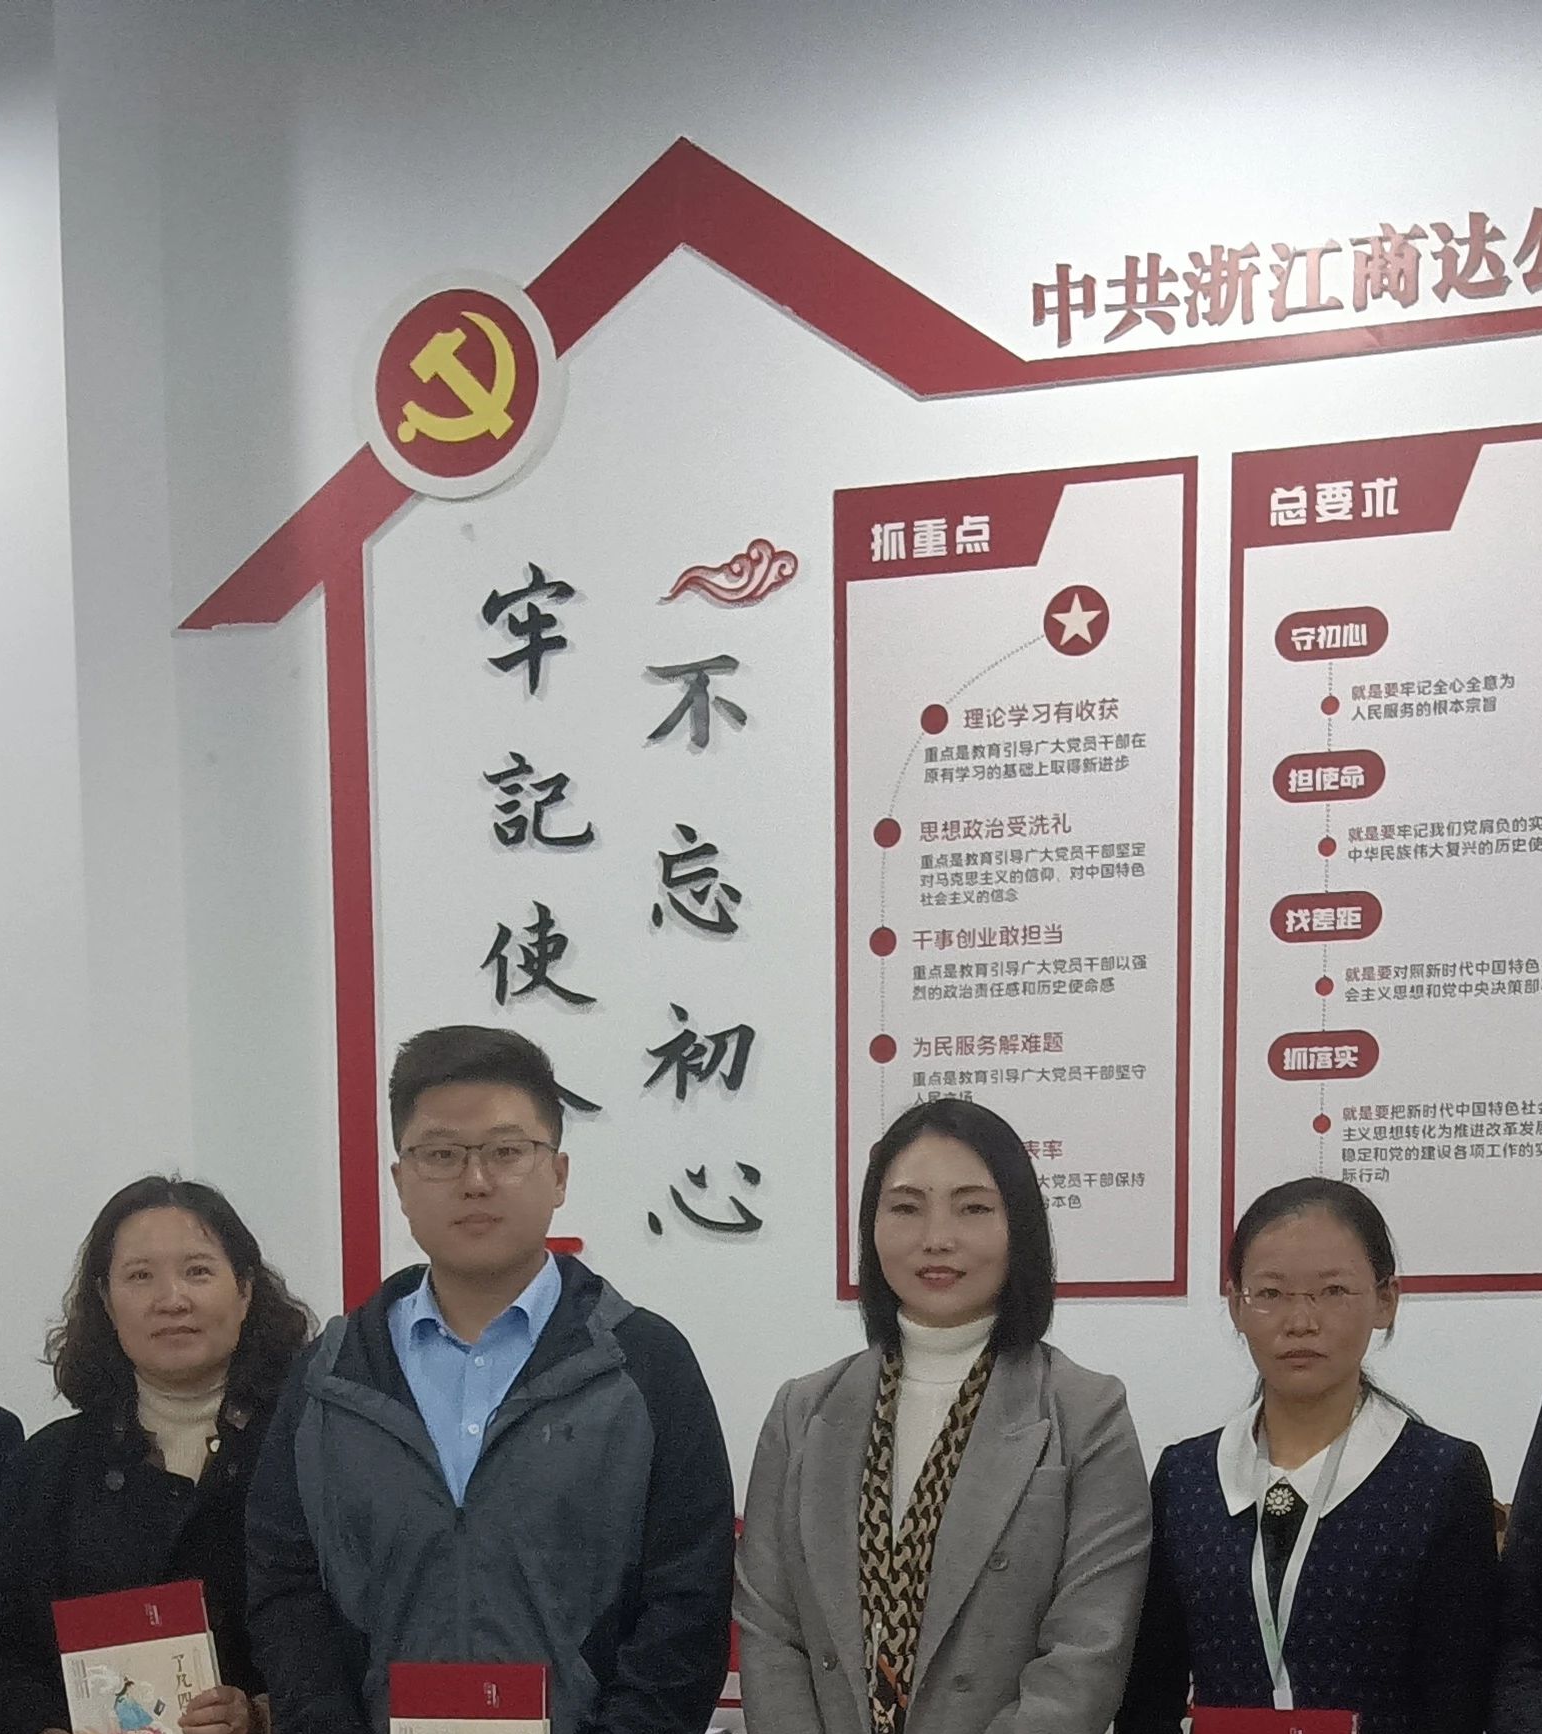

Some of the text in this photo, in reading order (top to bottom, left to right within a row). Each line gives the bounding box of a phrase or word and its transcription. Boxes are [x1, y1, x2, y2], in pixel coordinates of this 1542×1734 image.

[1270, 477, 1399, 527] 总要求
[870, 515, 991, 562] 抓重点
[1291, 622, 1369, 652] 守初心
[1351, 673, 1515, 702] 就是要牢记全心全意为
[963, 698, 1119, 729] 理论学习有收获
[1351, 696, 1497, 722] 人民服务的根本宗旨
[924, 733, 1147, 764] 重点是教育引导广大党员干部在
[924, 755, 1130, 784] 原有学习的基础上取得新进步
[1288, 764, 1365, 794] 担使命
[480, 563, 602, 1113] 牢記使
[920, 813, 1072, 842] 思想政治受洗礼
[920, 842, 1146, 870] 重点是教育引导广大党员干部坚定
[920, 889, 1019, 907] 社会主义的信念
[1285, 906, 1362, 933] 找差距
[644, 654, 764, 1237] 不忘初心
[913, 923, 1063, 950] 干事创业敢担当
[913, 955, 1147, 980] 重点是教育引导广大党员干部以强
[913, 977, 1115, 1001] 烈的政治责任感和历史使命感
[913, 1031, 1064, 1058] 为民服务解难题
[1283, 1045, 1359, 1071] 抓落实
[913, 1064, 1146, 1087] 重点是教育引导广大党员干部坚守
[1037, 1172, 1145, 1188] 大党员干部保持
[1342, 1168, 1390, 1183] 际行动
[171, 1653, 192, 1716] 了凡四
